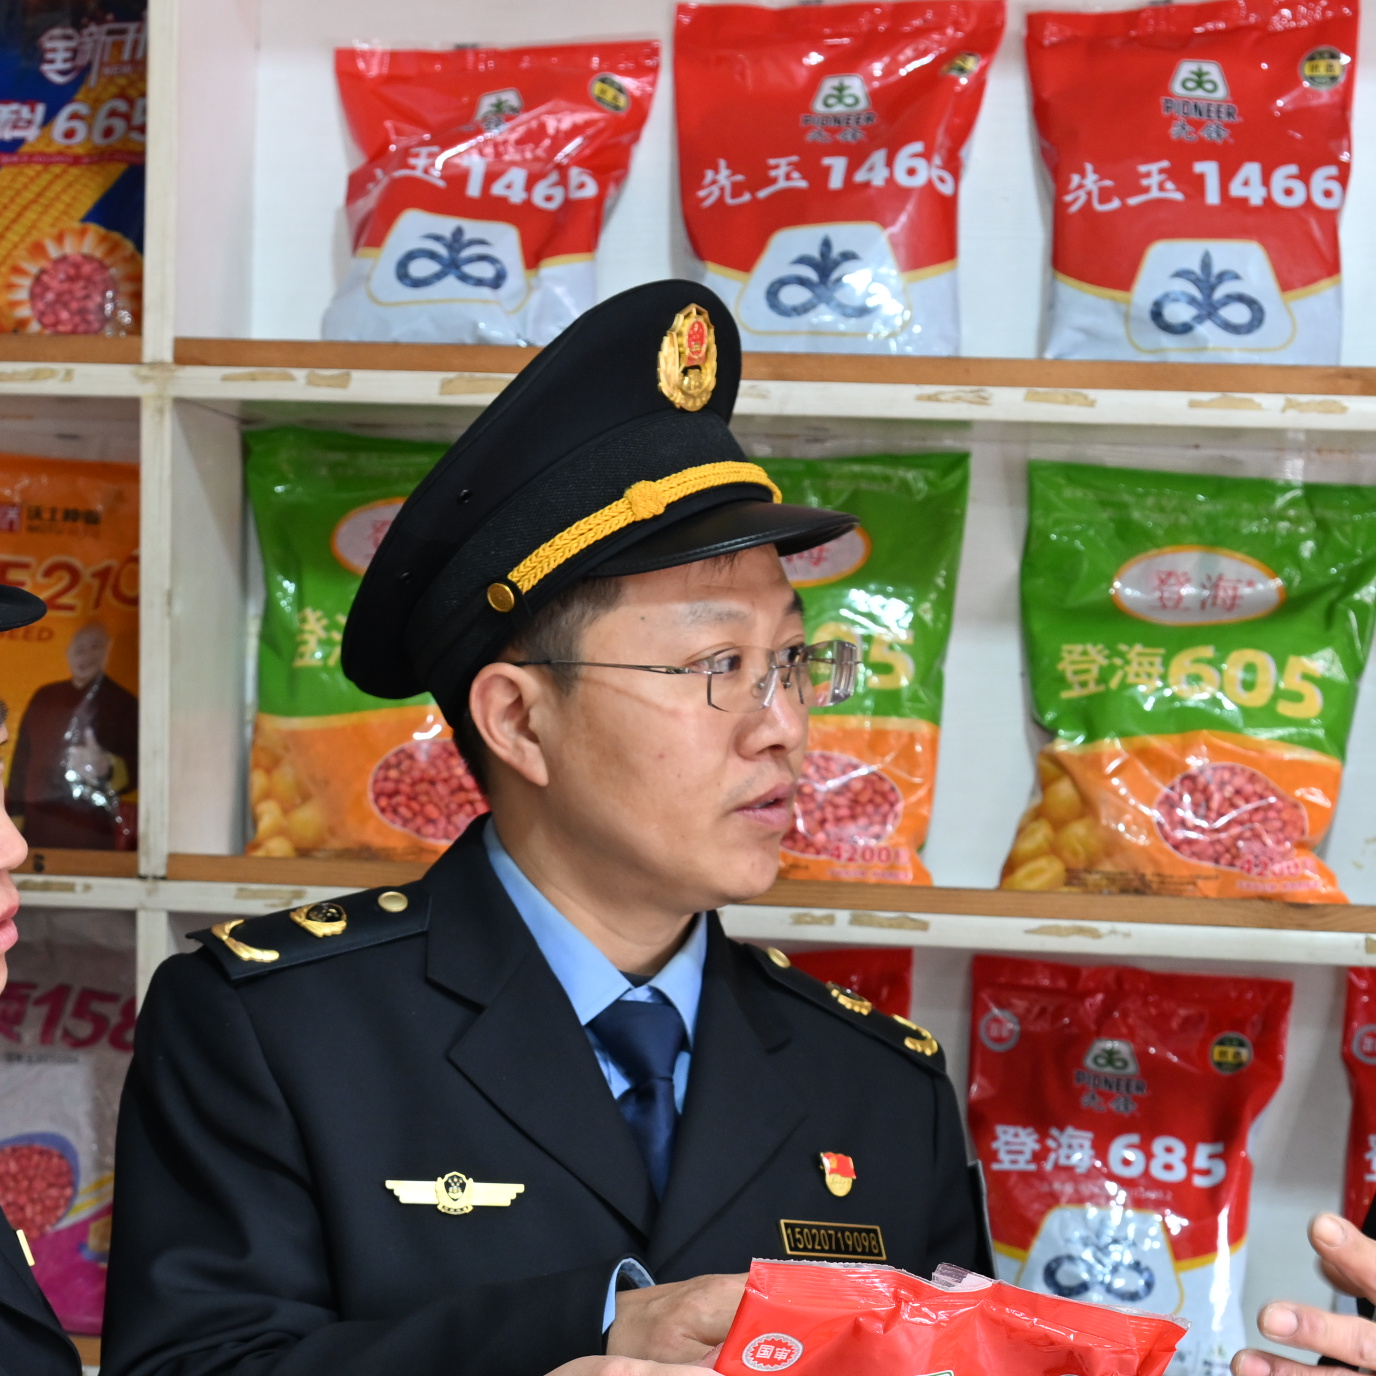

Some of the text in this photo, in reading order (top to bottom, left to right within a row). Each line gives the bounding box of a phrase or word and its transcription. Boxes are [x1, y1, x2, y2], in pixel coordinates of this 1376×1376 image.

[801, 112, 876, 127] PIONEER
[1162, 98, 1240, 123] PIONEER
[1062, 158, 1344, 214] 先玉1466
[1056, 640, 1325, 720] 登海605
[1074, 1069, 1148, 1096] PIONEER
[990, 1123, 1228, 1188] 登海685
[786, 1226, 881, 1254] 15020719098
[755, 1344, 792, 1362] 国审
